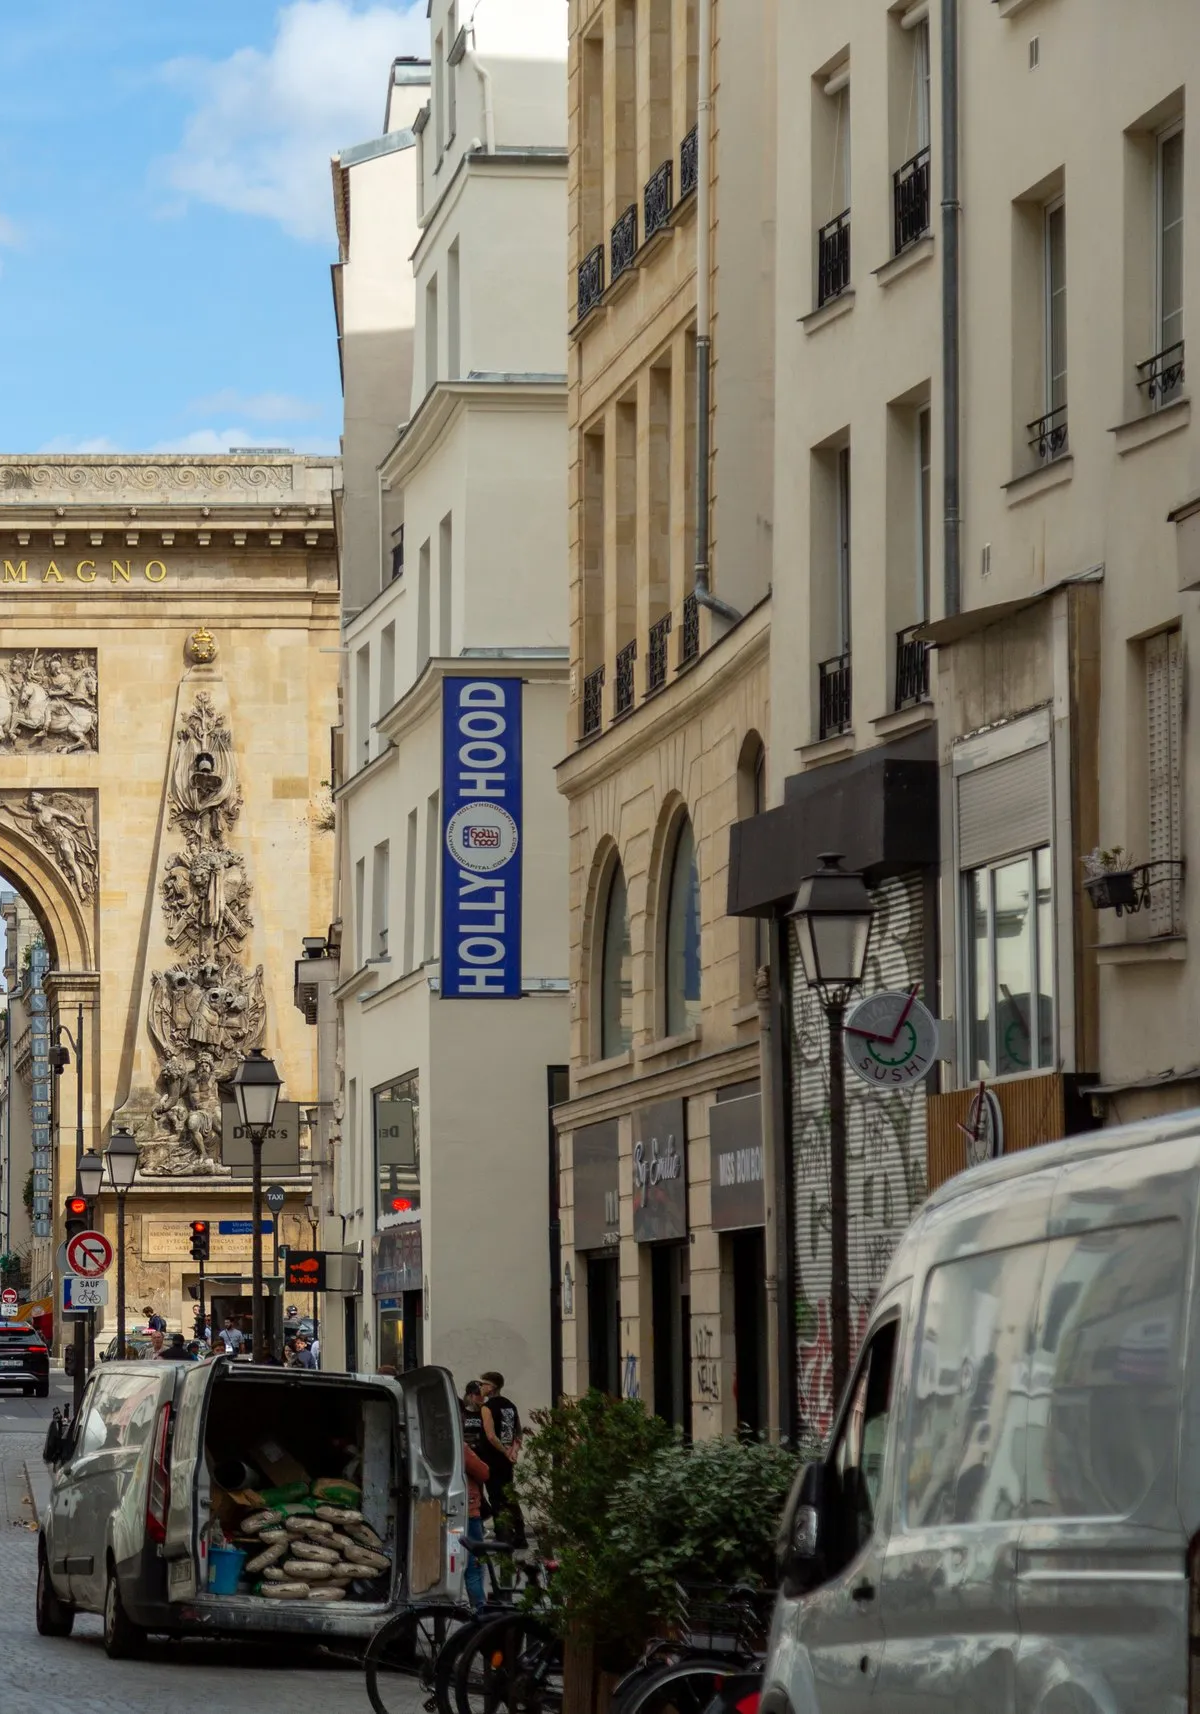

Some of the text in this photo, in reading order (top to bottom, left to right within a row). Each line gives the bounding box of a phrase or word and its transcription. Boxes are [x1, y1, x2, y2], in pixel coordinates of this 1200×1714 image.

[2, 559, 167, 583] MAGNO
[458, 682, 506, 993] HOLLY HOOD
[860, 1054, 927, 1082] SUSHI
[267, 1193, 284, 1201] TAXI
[290, 1275, 318, 1284] k-vibe
